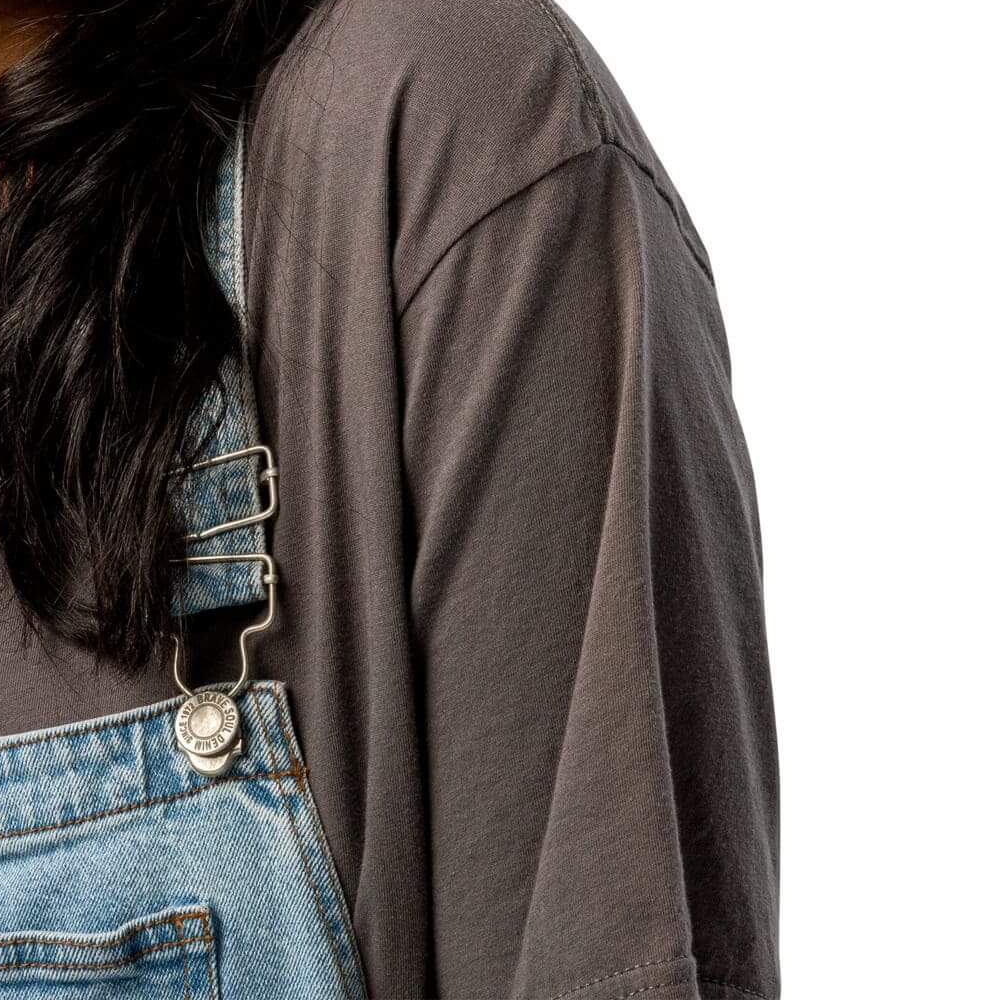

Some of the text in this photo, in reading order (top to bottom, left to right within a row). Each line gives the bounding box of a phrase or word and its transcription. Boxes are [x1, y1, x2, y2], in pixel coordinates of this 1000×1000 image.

[196, 692, 229, 709] BRAVE
[224, 707, 236, 734] SOUL
[194, 734, 226, 752] DENIM
